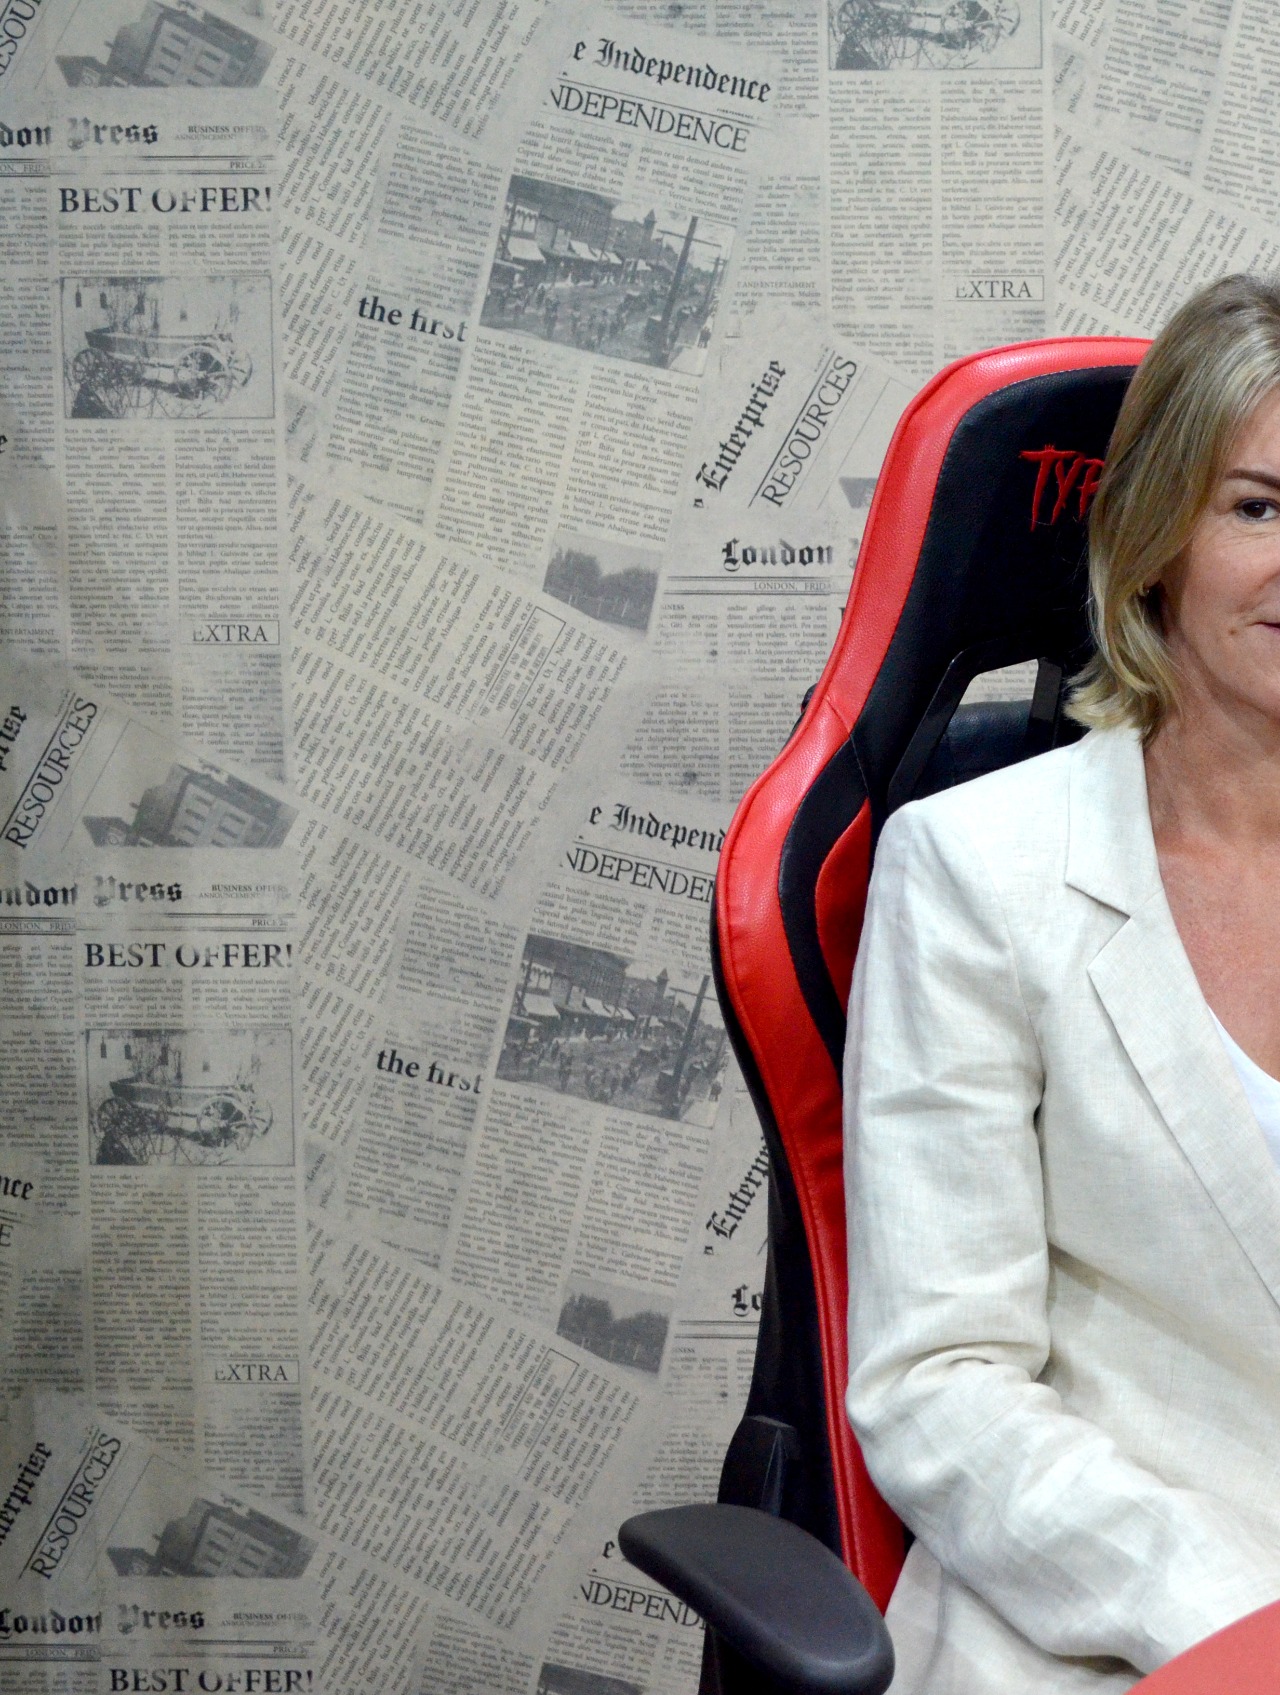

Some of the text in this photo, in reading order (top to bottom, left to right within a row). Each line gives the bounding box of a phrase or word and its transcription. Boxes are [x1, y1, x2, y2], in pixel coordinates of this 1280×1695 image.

[593, 38, 771, 103] Independence
[67, 116, 159, 151] Press
[58, 186, 272, 214] BEST OFFER!
[358, 296, 468, 342] the first
[696, 360, 786, 492] Enterprise
[761, 355, 856, 507] RESOURCES
[722, 538, 833, 572] London
[5, 697, 97, 849] RESOURCES
[92, 875, 183, 908] Press
[84, 942, 293, 969] BEST OFFER!
[376, 1049, 483, 1094] the first
[30, 1433, 121, 1580] RESOURCES
[117, 1603, 206, 1635] Press
[109, 1667, 314, 1694] BEST OFFER!
